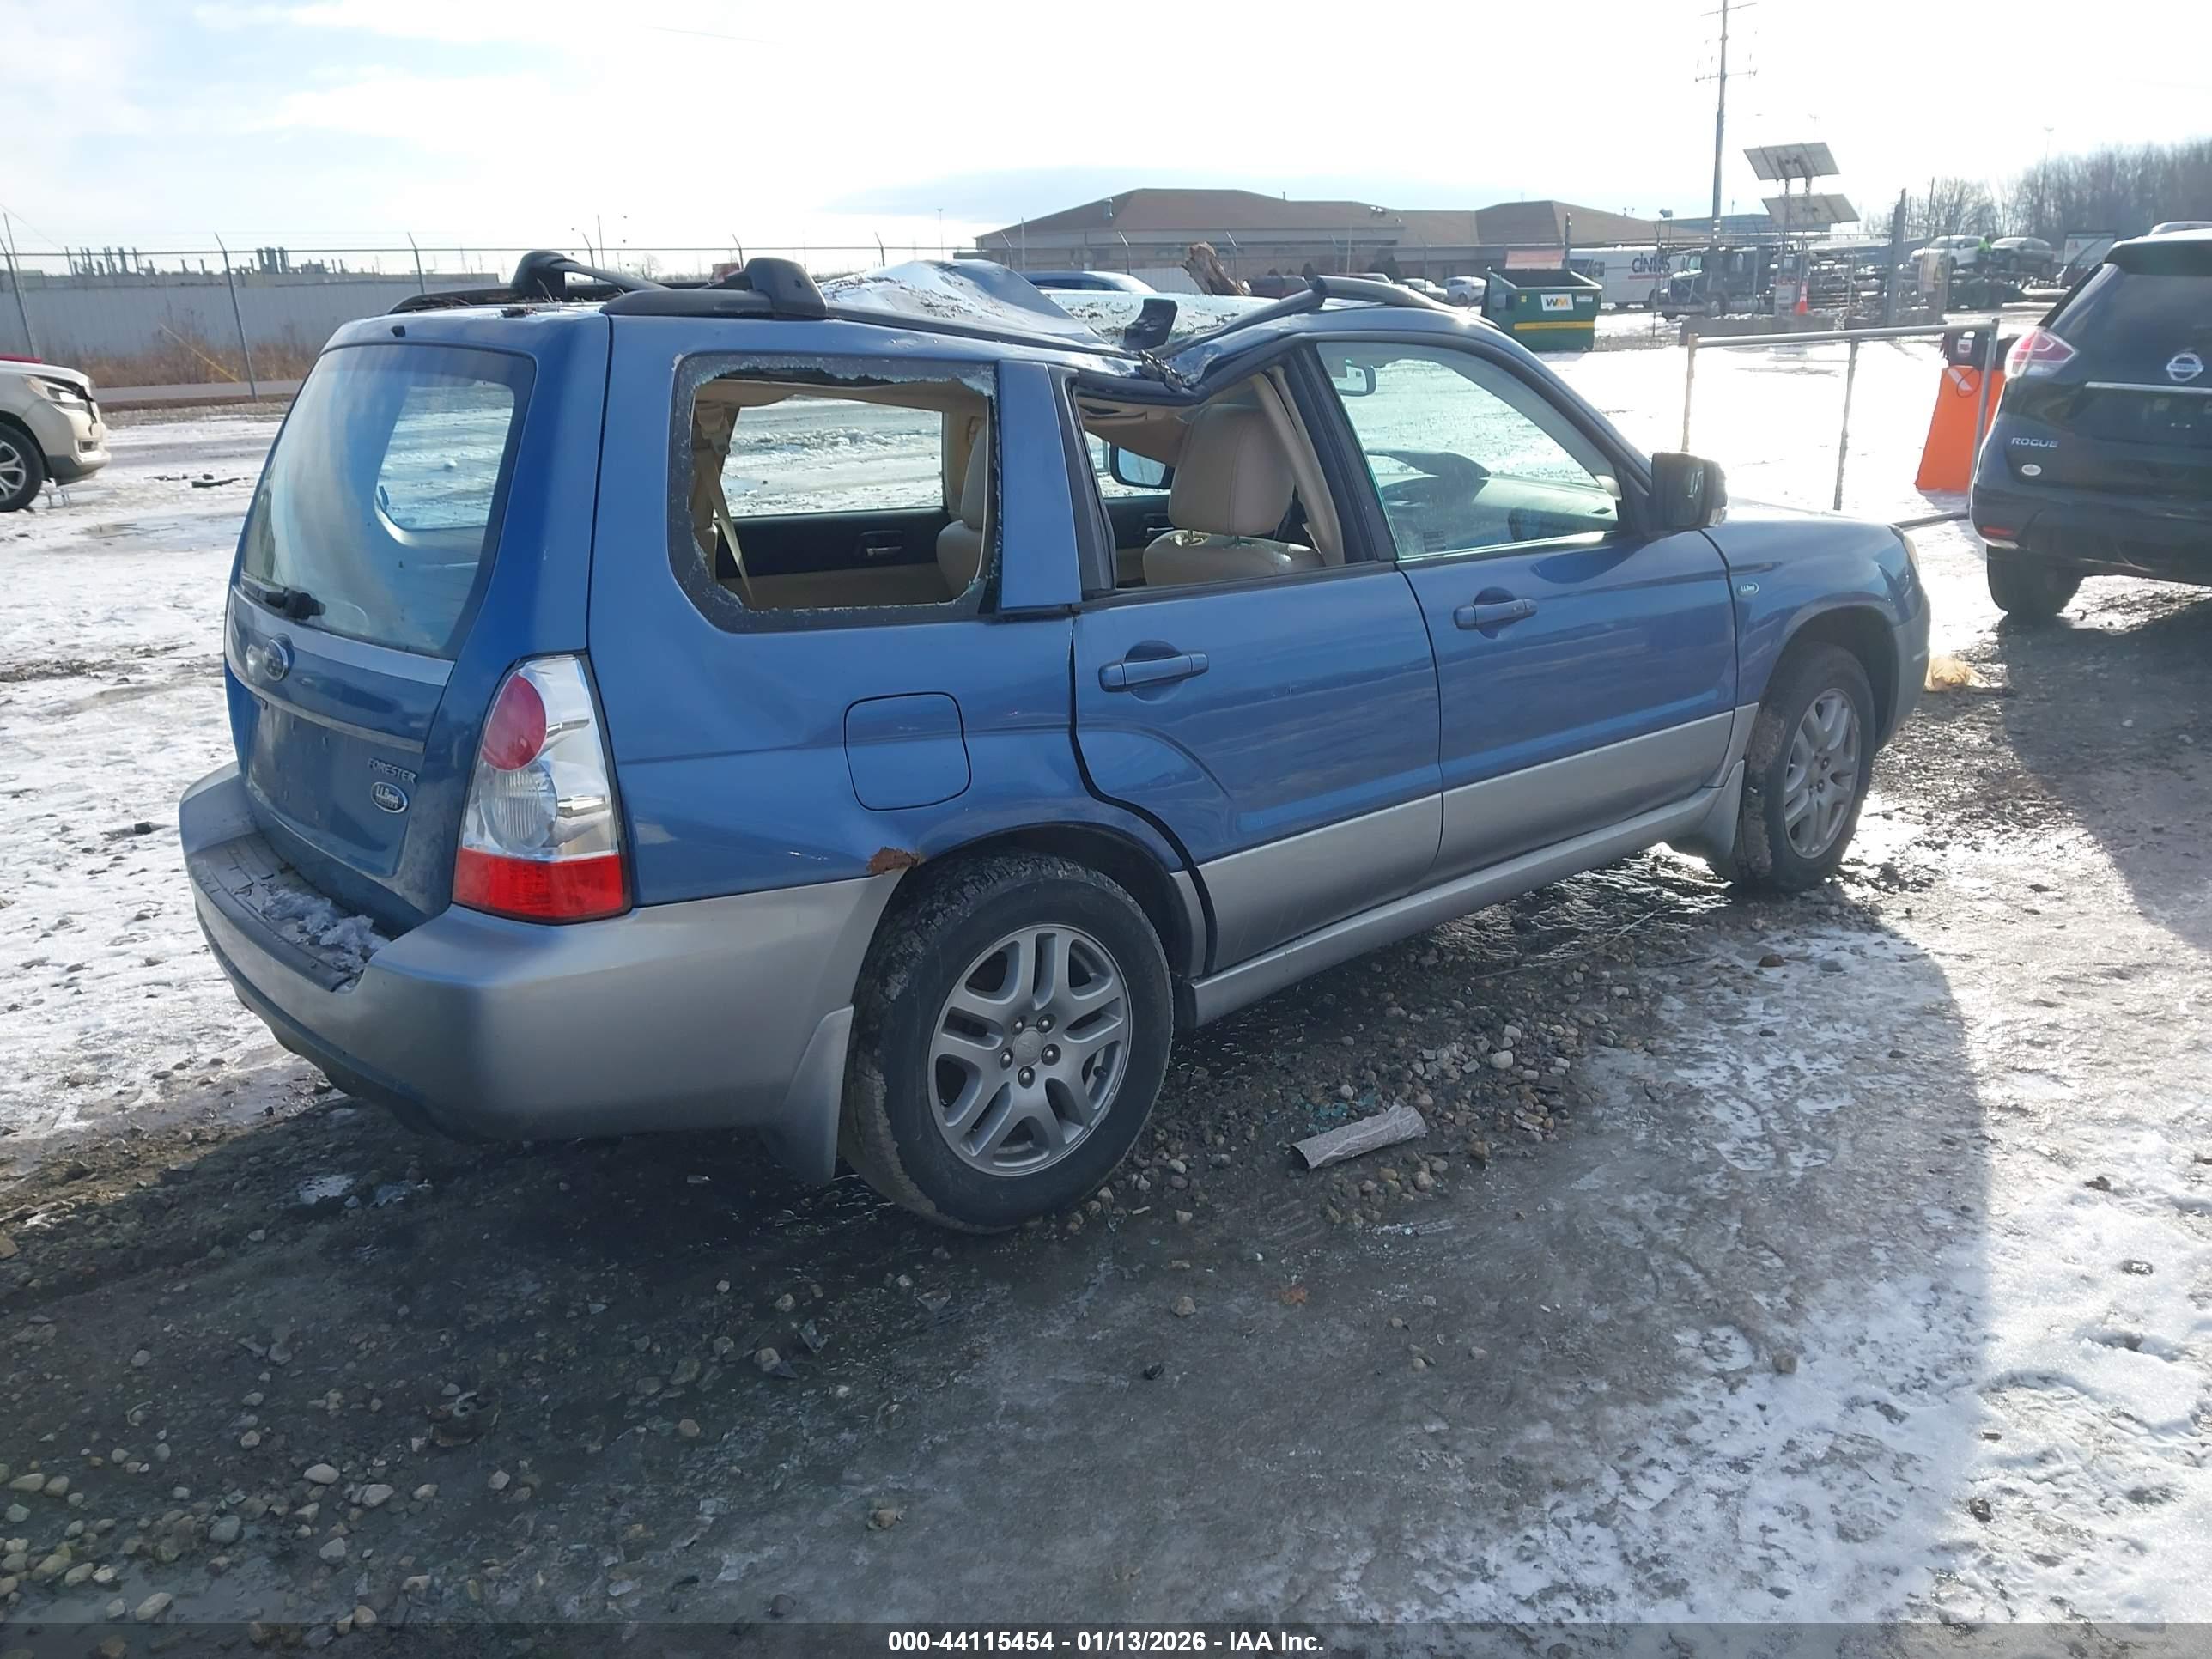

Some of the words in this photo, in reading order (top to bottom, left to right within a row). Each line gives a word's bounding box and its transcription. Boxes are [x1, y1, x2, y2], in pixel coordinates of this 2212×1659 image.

[1546, 298, 1568, 307] WM
[2011, 437, 2059, 447] ROGUE
[367, 757, 417, 783] FORESTER
